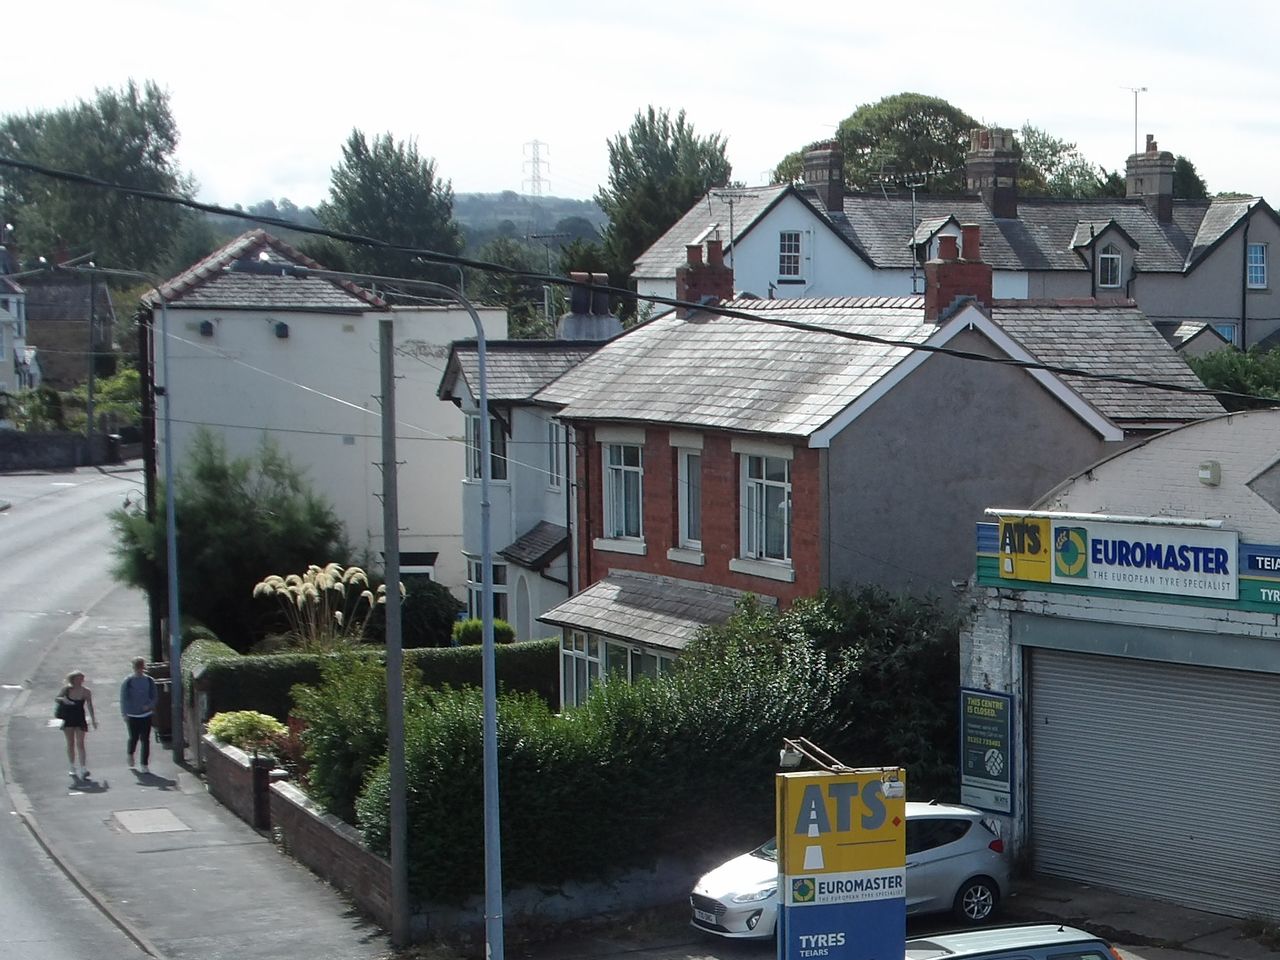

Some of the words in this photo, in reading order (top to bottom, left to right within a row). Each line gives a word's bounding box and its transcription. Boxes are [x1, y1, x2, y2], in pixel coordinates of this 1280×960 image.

[1000, 522, 1041, 555] ATS
[1091, 538, 1230, 575] EUROMASTER
[1093, 571, 1108, 580] THE
[1112, 572, 1155, 585] EUROPEAN
[1159, 576, 1180, 587] TYRE
[1183, 579, 1231, 591] SPECIALIST
[794, 779, 887, 835] ATS
[818, 875, 903, 894] EUROMASTER
[800, 933, 845, 948] TYRES
[800, 949, 828, 957] TEIARS
